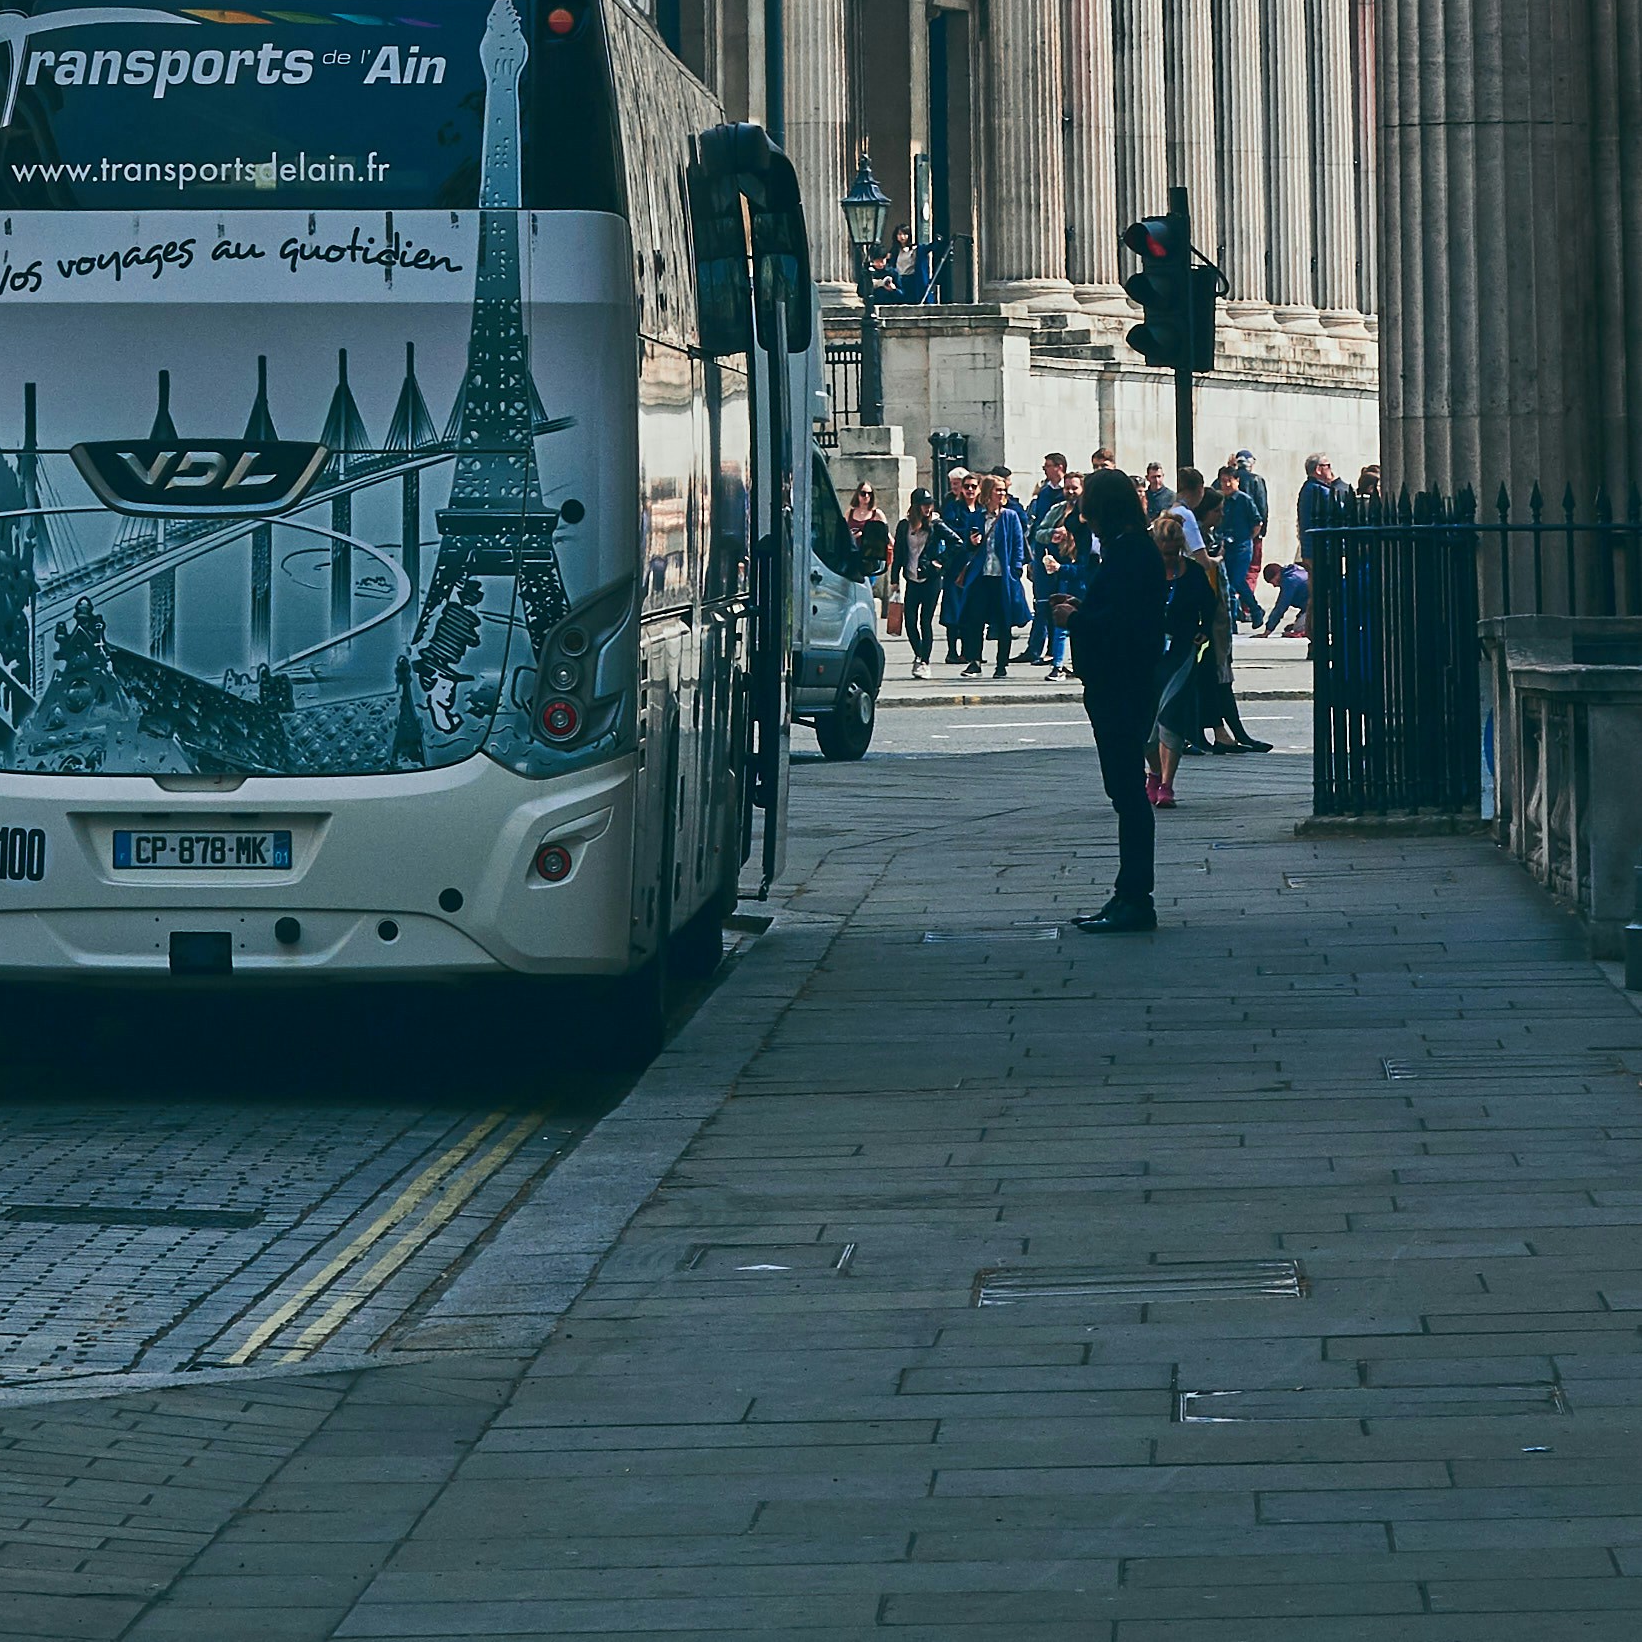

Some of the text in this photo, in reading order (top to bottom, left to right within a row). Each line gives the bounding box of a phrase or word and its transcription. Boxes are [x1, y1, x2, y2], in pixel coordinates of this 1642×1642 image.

[321, 49, 351, 66] de
[11, 151, 391, 190] www.transportsdelain.fr
[58, 236, 197, 281] voyages
[211, 238, 266, 260] au
[279, 226, 463, 274] quotidien
[115, 451, 278, 491] VDL
[135, 835, 268, 864] CP-878-MK
[274, 850, 289, 865] 01
